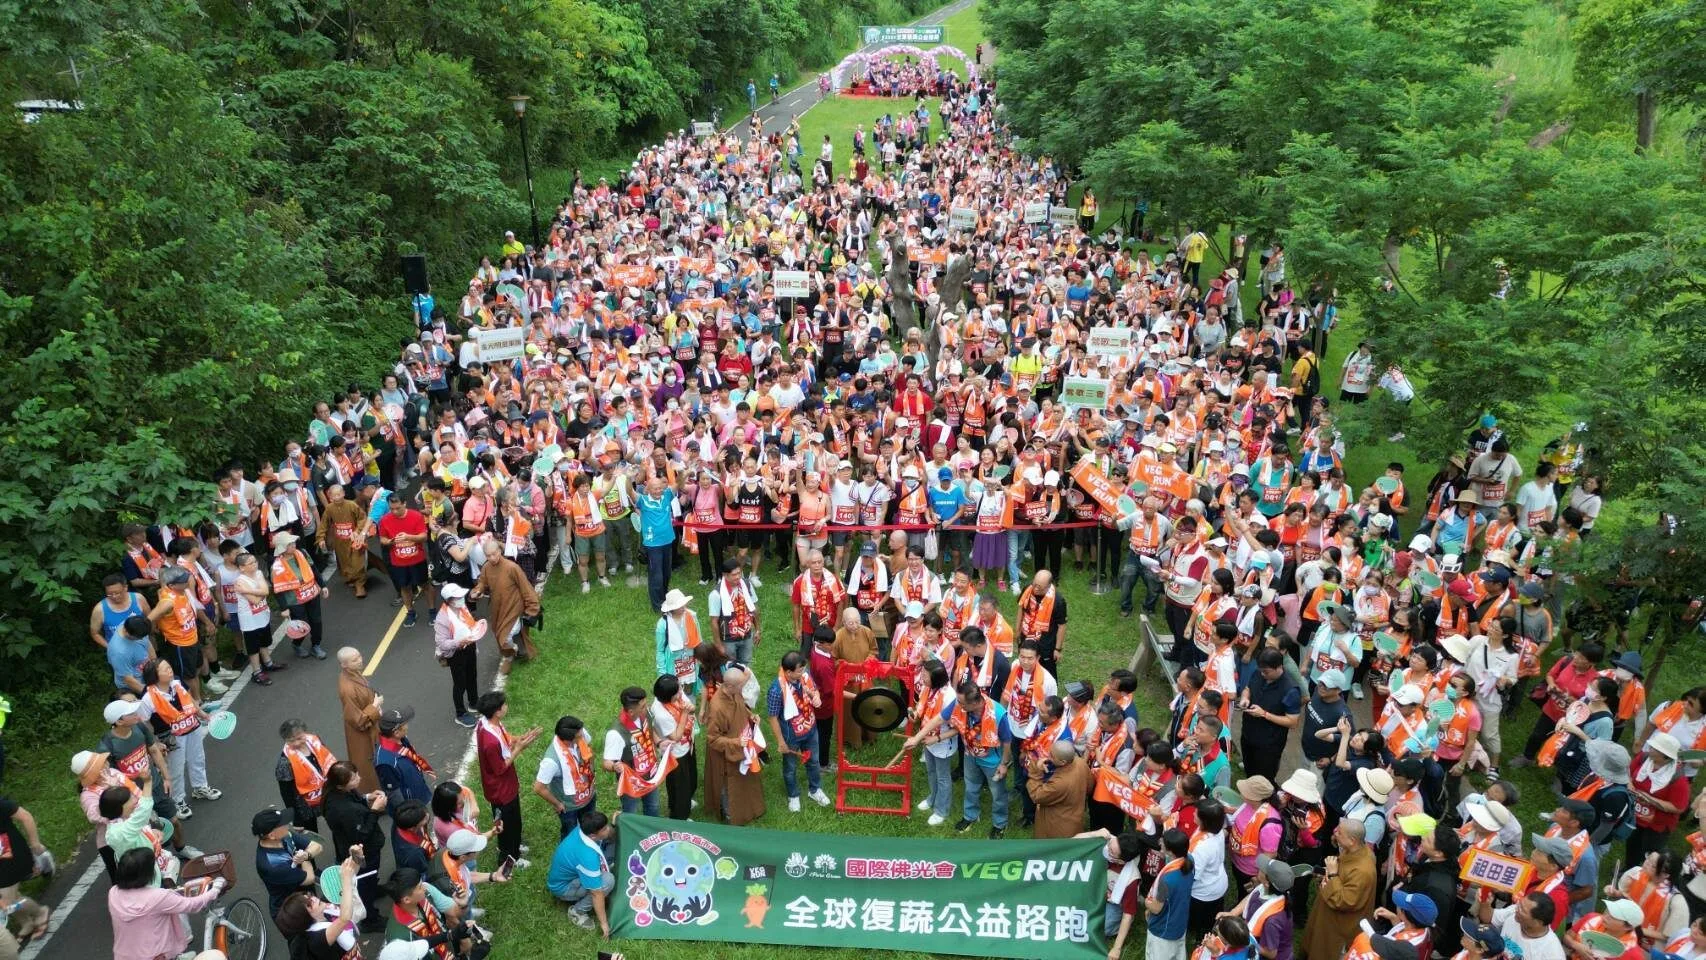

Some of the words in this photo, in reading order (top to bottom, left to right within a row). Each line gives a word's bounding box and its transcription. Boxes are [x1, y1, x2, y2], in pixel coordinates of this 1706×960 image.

[1144, 464, 1163, 475] VEG
[1087, 473, 1110, 491] VEG
[1153, 476, 1172, 486] RUN
[1092, 488, 1116, 506] RUN
[396, 546, 417, 556] 1497
[1104, 779, 1132, 800] VEG
[1120, 798, 1145, 818] RUN
[750, 871, 766, 879] RUN
[846, 858, 956, 879] 國際佛光會
[960, 859, 1094, 882] VEGRUN
[1470, 858, 1518, 886] 祖田里
[784, 895, 1089, 943] 全球復蔬公益路跑
